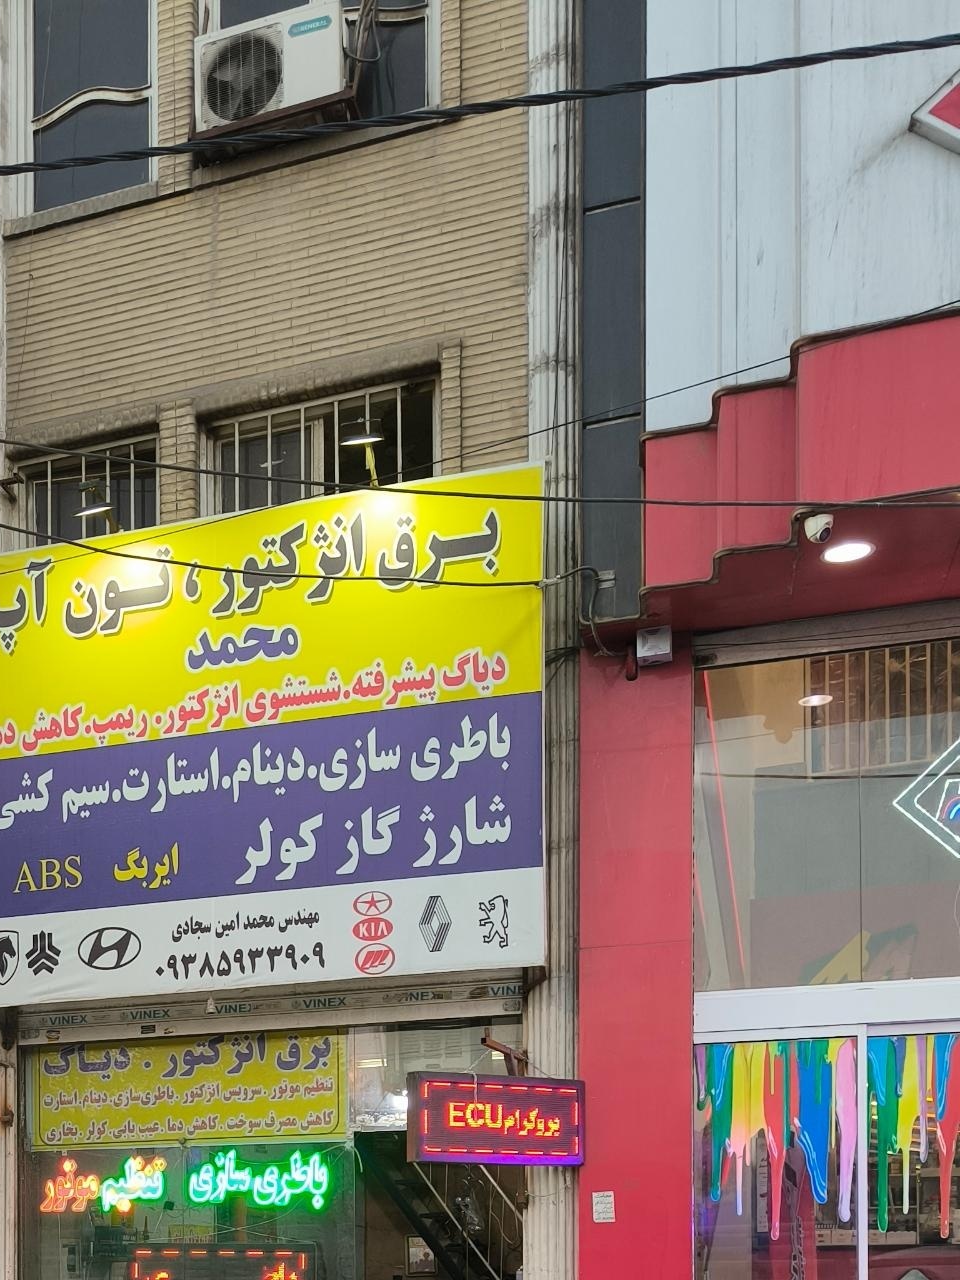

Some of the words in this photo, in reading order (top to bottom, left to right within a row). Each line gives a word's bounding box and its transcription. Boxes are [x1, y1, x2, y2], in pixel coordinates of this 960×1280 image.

[376, 507, 503, 592] برق
[62, 546, 174, 638] تون
[186, 622, 301, 672] محمد
[441, 649, 509, 695] دیاگ
[243, 670, 342, 726] شستشوی
[21, 705, 83, 756] کاهش
[410, 710, 513, 784] باطری
[60, 778, 110, 824] سیم
[235, 813, 325, 886] کولر
[336, 804, 401, 876] گاز
[412, 794, 514, 868] شارژ
[13, 854, 84, 895] ABS
[111, 842, 181, 889] ایربگ
[171, 914, 212, 943] سجادی
[215, 911, 240, 938] امین
[243, 912, 276, 931] محمد
[278, 907, 321, 934] مهندس
[358, 920, 389, 938] KIA
[155, 941, 326, 981] ۰۹۳۸۵۹۳۳۹۰۹
[49, 1014, 89, 1026] VINEX
[129, 1008, 172, 1021] VINEX
[302, 996, 347, 1009] VINEX
[44, 1043, 131, 1081] دیاگ
[162, 1032, 267, 1079] انژکتور
[275, 1033, 333, 1072] برق
[270, 1079, 301, 1101] موتور
[303, 1077, 334, 1098] تنظیم
[300, 1110, 334, 1131] کاهش
[448, 1102, 503, 1129] ECU
[40, 1157, 100, 1214] موتور
[188, 1150, 251, 1203] سازی
[253, 1150, 330, 1211] باطری
